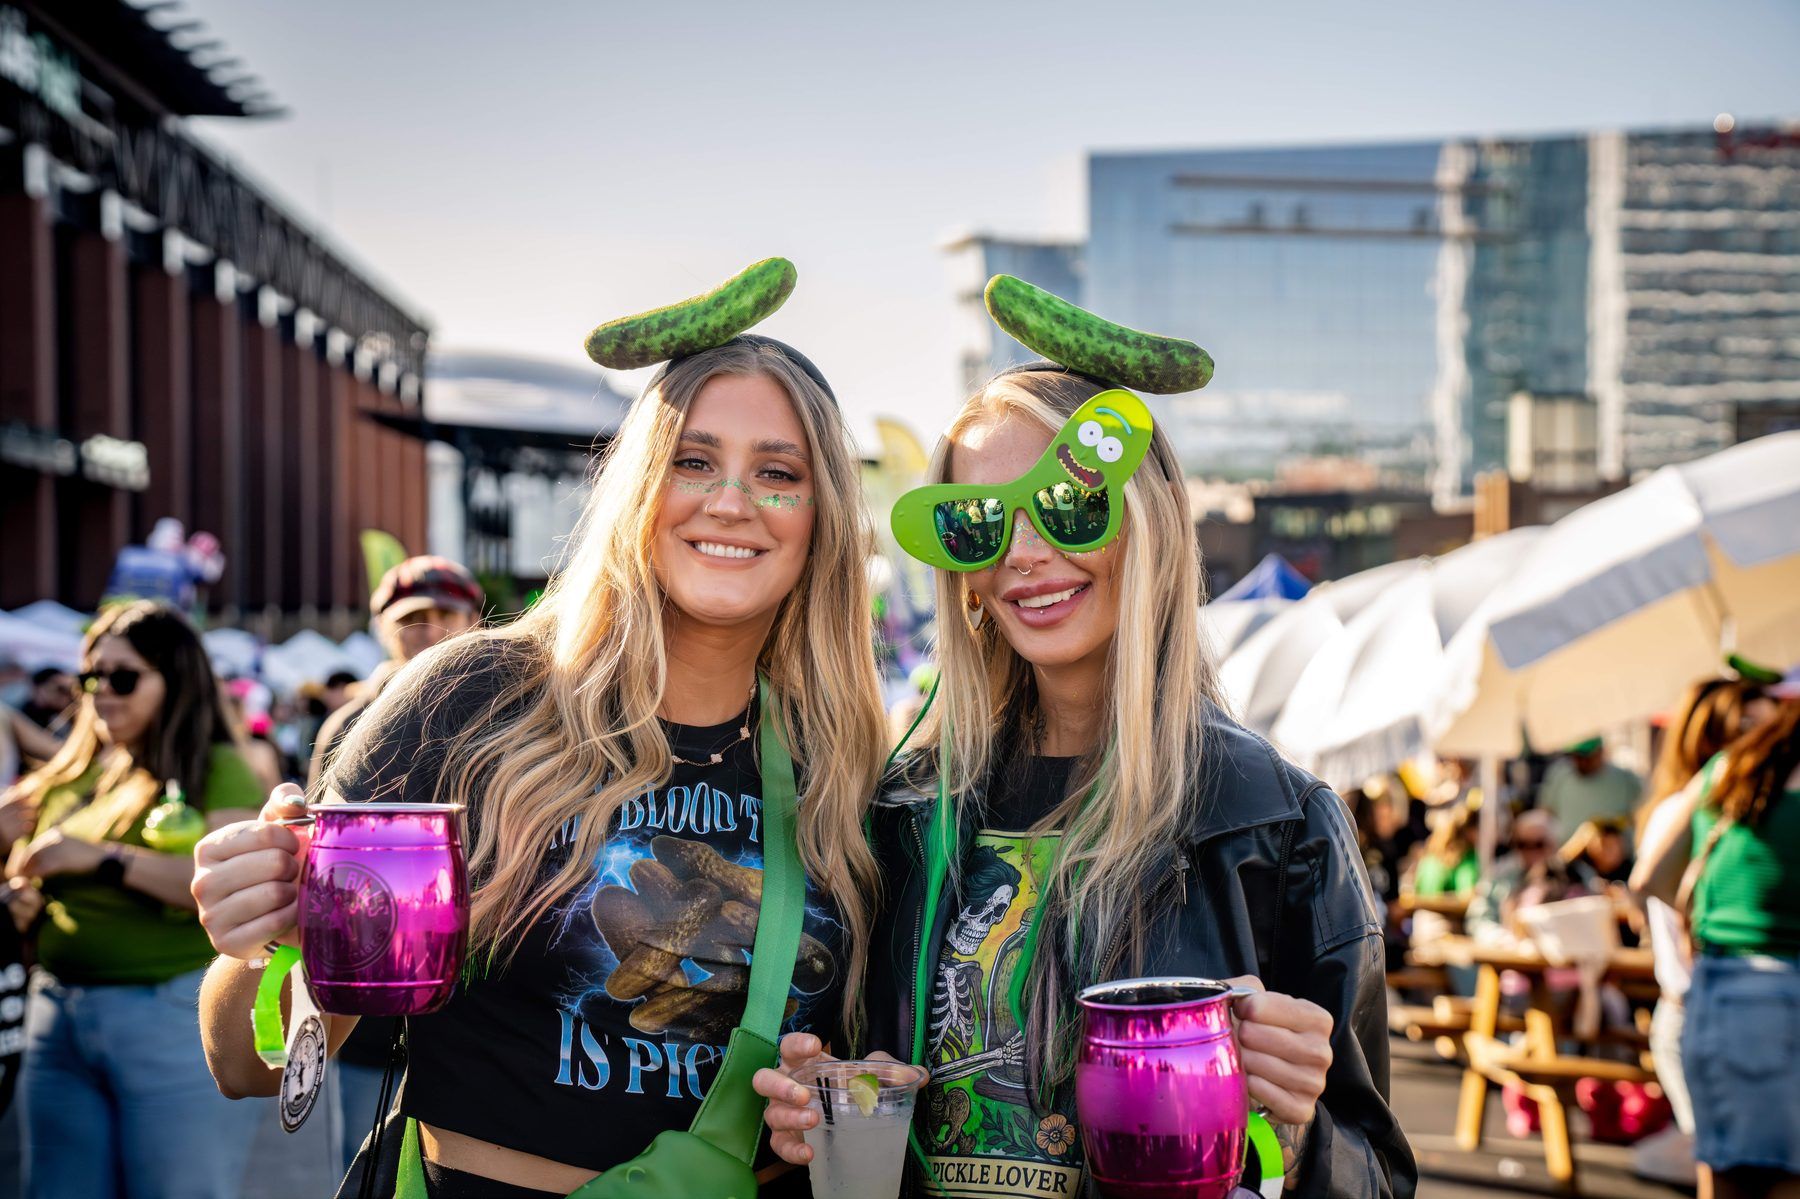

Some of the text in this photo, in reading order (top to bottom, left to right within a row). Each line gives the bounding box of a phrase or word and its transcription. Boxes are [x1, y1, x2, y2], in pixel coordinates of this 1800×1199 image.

[553, 1008, 729, 1101] IS PIC
[933, 1161, 991, 1185] PICKLE
[994, 1164, 1069, 1194] LOVER
